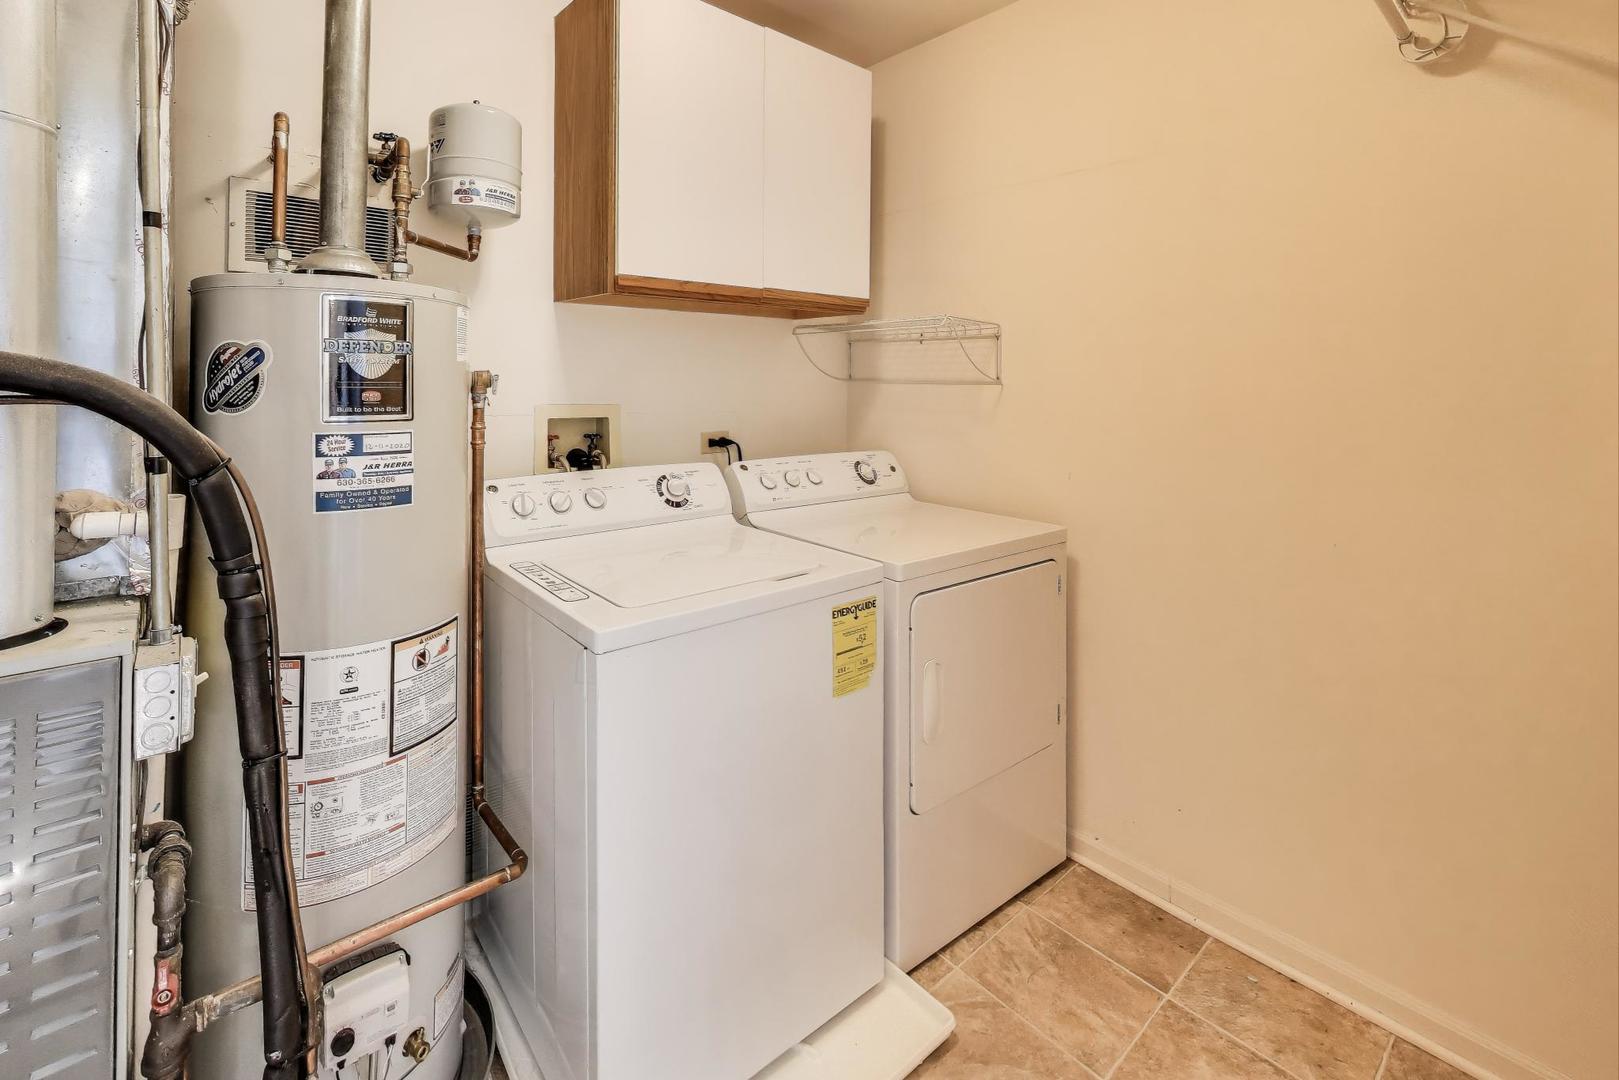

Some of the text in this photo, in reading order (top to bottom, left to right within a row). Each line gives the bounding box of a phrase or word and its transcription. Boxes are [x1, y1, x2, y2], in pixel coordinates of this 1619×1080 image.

[337, 315, 378, 324] BRADFORD
[379, 317, 404, 325] WHITE
[323, 338, 414, 355] DEFENDER
[362, 461, 413, 471] J&R HERRA
[346, 490, 372, 498] Owned
[380, 486, 410, 495] Operated
[832, 599, 877, 619] ENERGYGUIDE
